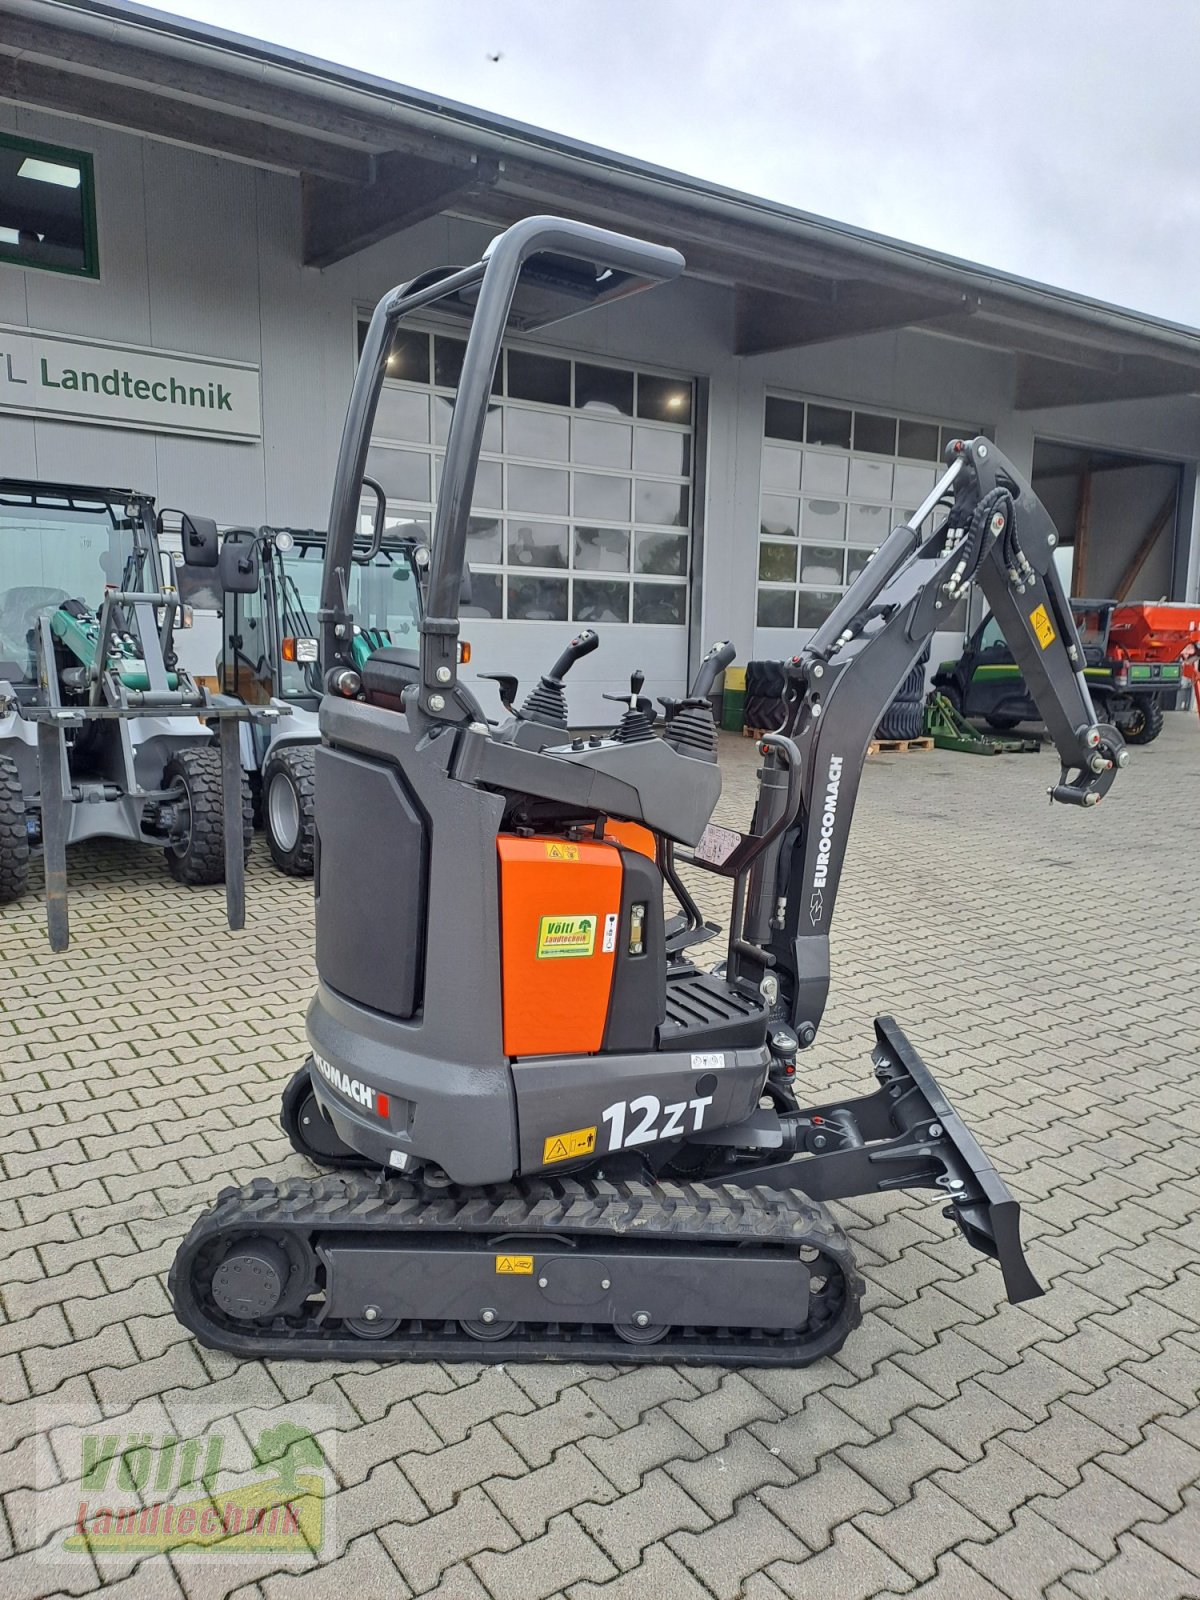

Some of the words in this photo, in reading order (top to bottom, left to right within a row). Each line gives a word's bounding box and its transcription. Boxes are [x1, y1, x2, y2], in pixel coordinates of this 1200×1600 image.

[0, 352, 27, 384] L
[41, 358, 232, 411] Landtechnik
[813, 756, 844, 888] EUROCOMACH
[544, 934, 586, 943] Landtechnik
[547, 922, 575, 934] Völtl
